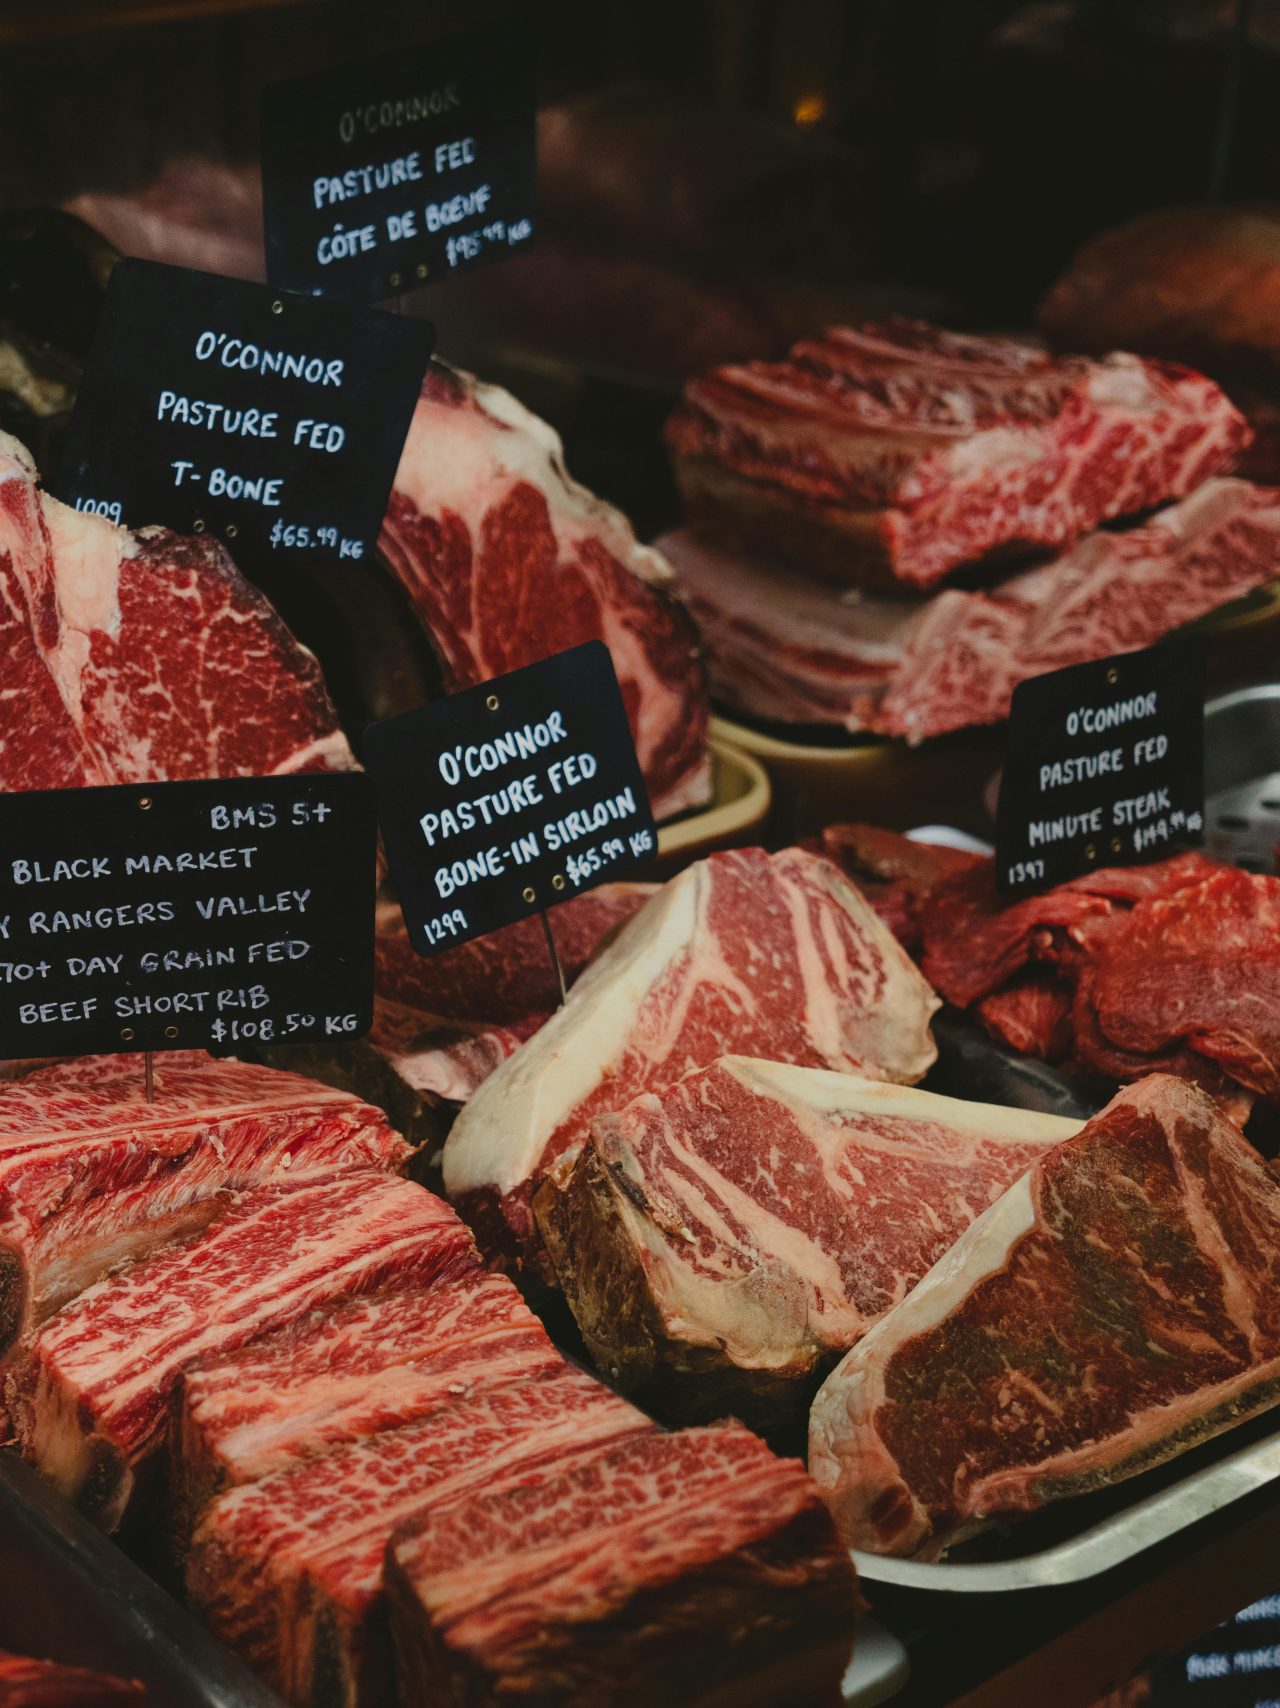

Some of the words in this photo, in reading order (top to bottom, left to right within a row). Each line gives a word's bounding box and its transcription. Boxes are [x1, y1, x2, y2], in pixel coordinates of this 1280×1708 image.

[340, 80, 460, 142] O'CONNOR
[313, 152, 423, 209] PASTURE
[434, 137, 476, 173] FED
[316, 223, 377, 264] CÔTE
[386, 210, 418, 242] DE
[195, 331, 344, 387] O'CONNOR
[157, 391, 279, 438] PASTURE
[293, 419, 346, 452] FED
[269, 518, 337, 549] $65.99
[339, 538, 364, 559] KG
[1066, 691, 1157, 735] O'CONNOR
[438, 710, 568, 786] O'CONNOR
[1040, 748, 1123, 791] PASTURE
[1134, 734, 1167, 765] FED
[210, 801, 277, 830] BMS
[291, 801, 332, 827] 5+
[420, 774, 543, 847] PASTURE
[547, 752, 597, 794] FED
[1029, 807, 1103, 847] MINUTE
[1112, 786, 1171, 826] STEAK
[12, 857, 111, 885] BLACK
[125, 847, 258, 876] MARKET
[435, 832, 540, 899] BONE-IN
[543, 786, 637, 850] SIRLOIN
[566, 838, 625, 887] $65.99
[629, 830, 653, 857] KG
[29, 902, 175, 935] RANGERS
[196, 888, 311, 919] VALLEY
[424, 909, 468, 945] 1299
[68, 955, 124, 976] DAY
[140, 946, 235, 974] GRAIN
[248, 940, 311, 963] FED
[19, 998, 98, 1024] BEEF
[115, 992, 209, 1017] SHORT
[217, 984, 271, 1010] RIB
[210, 1013, 316, 1043] $108.50
[325, 1014, 358, 1036] KG
